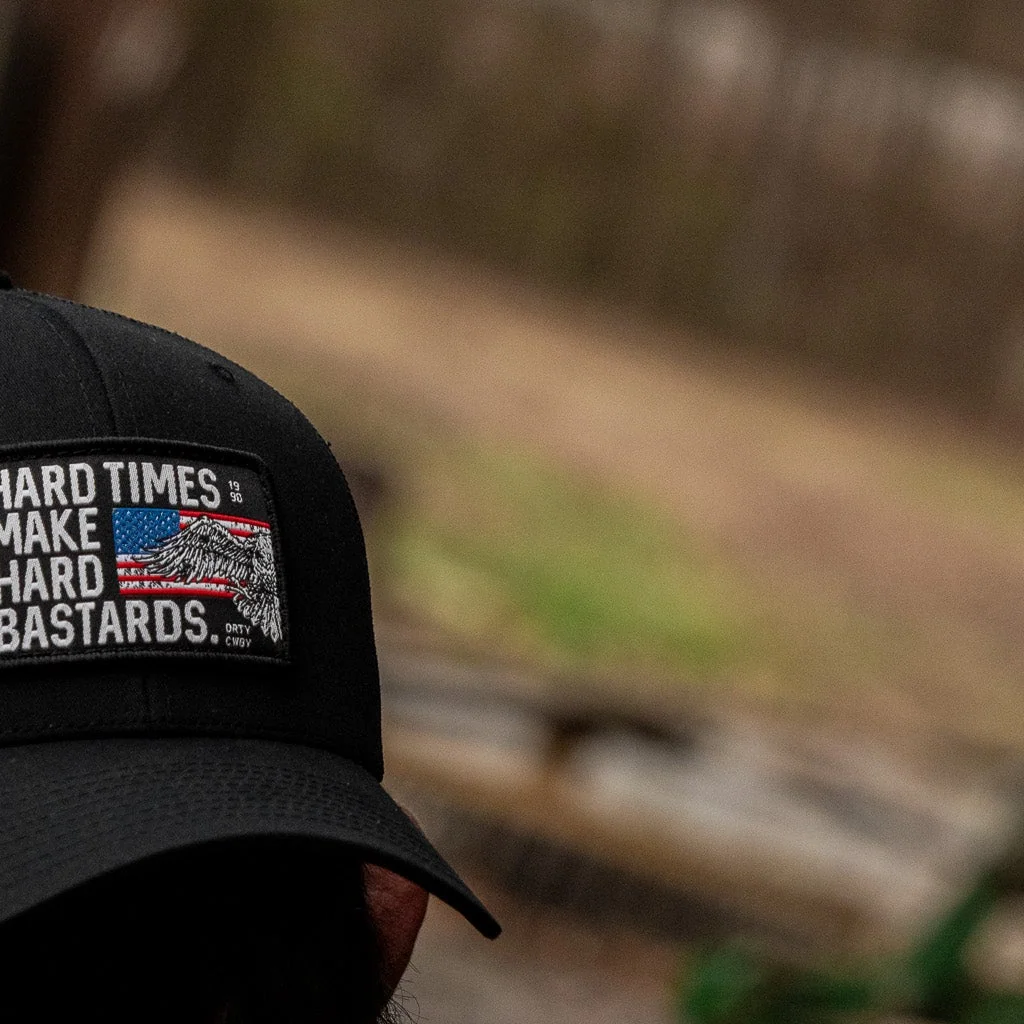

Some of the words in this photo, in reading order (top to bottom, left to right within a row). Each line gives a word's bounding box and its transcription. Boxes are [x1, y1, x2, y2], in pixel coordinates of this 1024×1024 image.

[103, 461, 221, 509] TIMES
[227, 480, 240, 491] 19
[229, 491, 243, 503] 90
